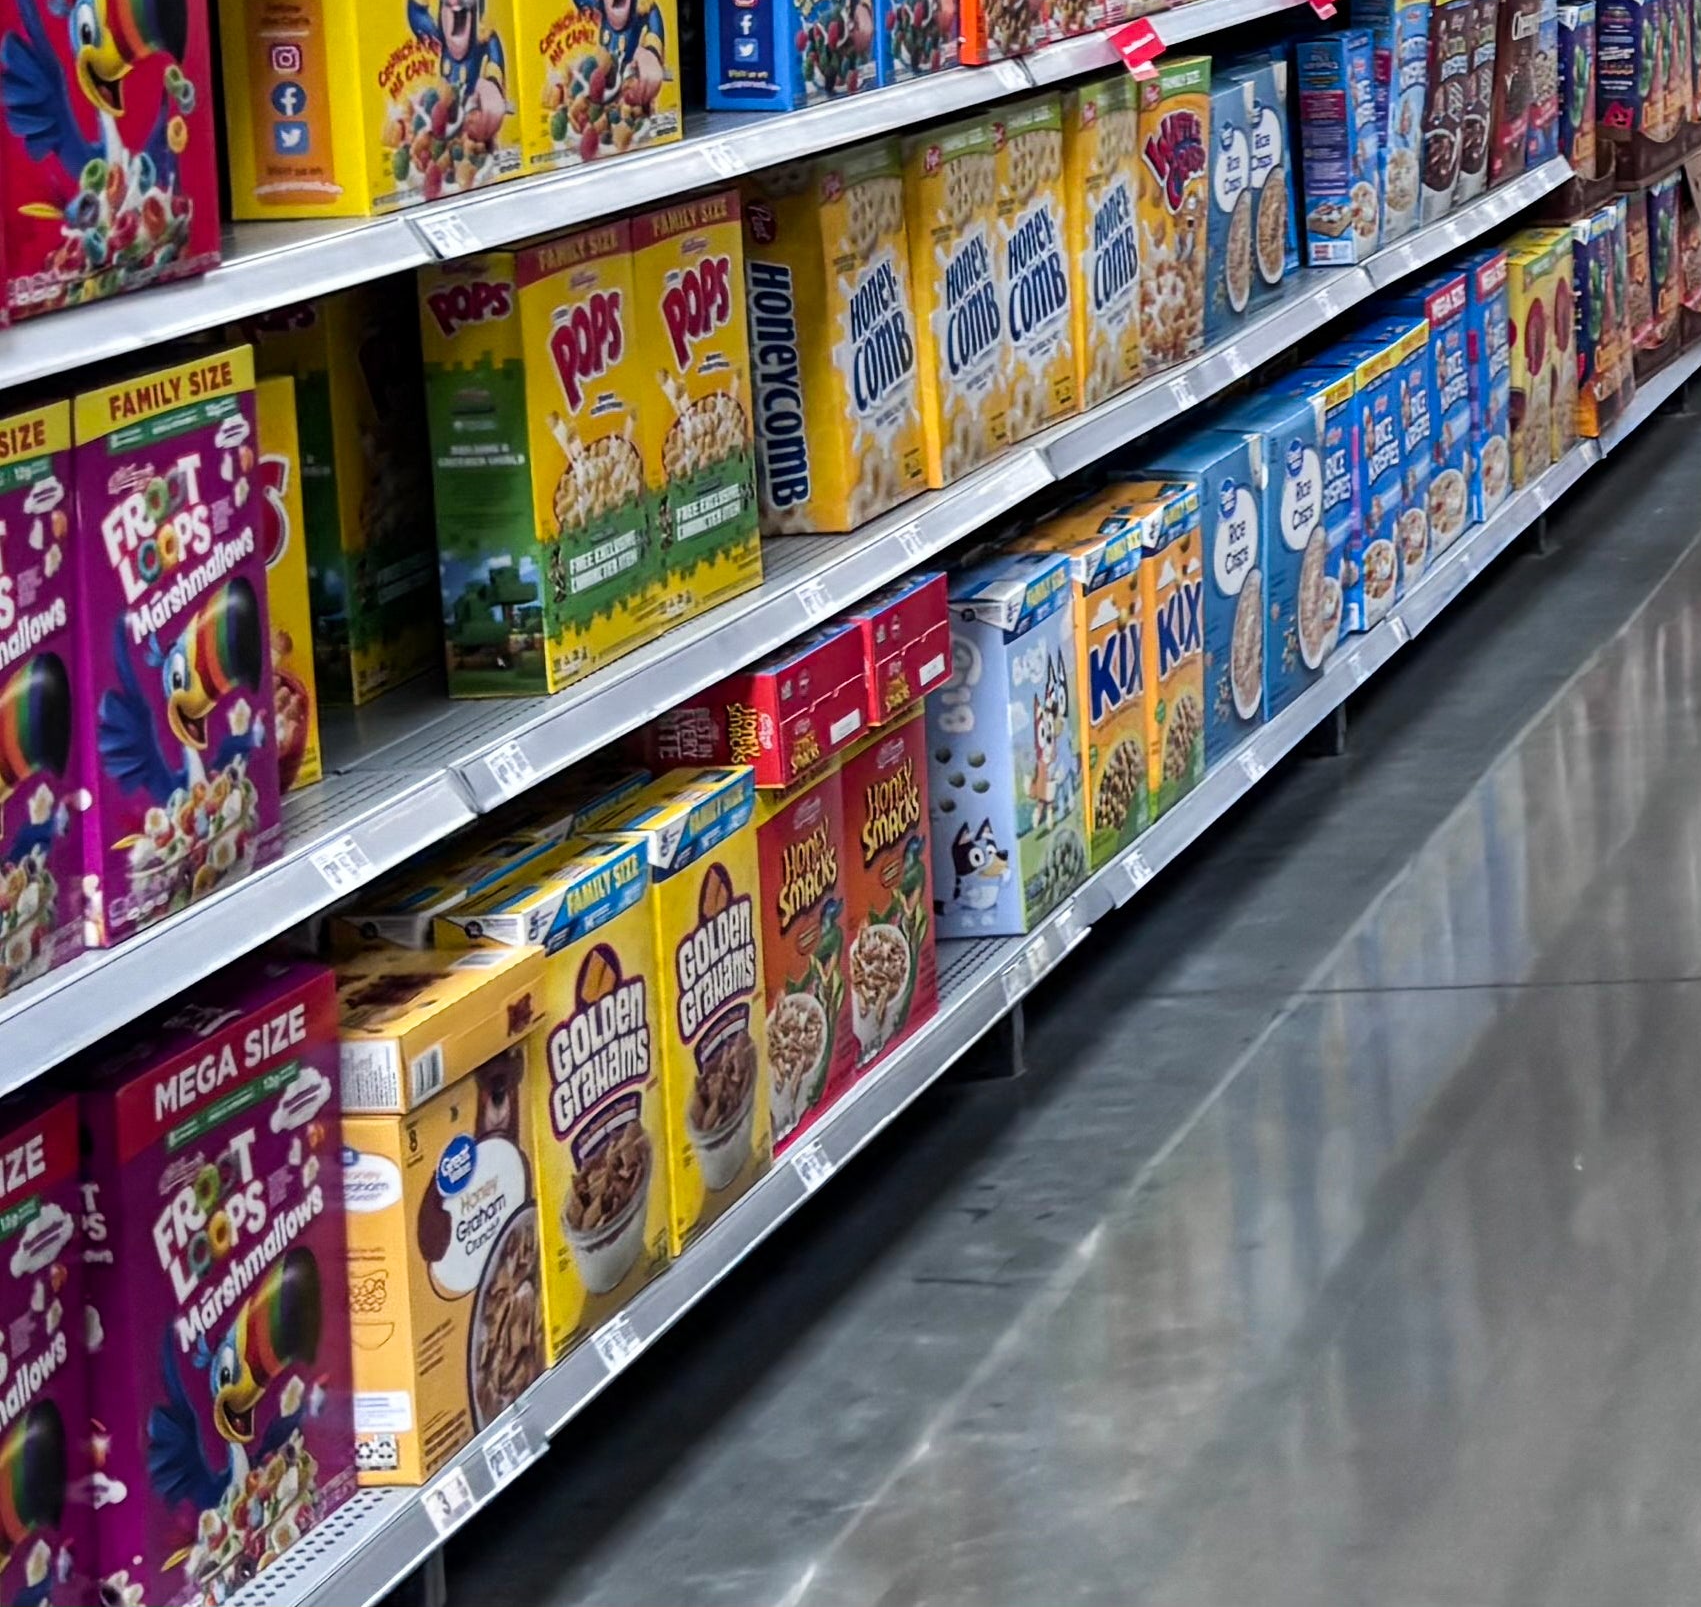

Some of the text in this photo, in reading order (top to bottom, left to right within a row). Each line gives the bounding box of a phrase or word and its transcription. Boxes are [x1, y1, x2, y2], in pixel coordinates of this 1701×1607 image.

[427, 280, 510, 339] POPS
[550, 290, 623, 415] POPS
[662, 256, 730, 372] POPS
[109, 361, 234, 423] FAMILY SIZE
[102, 455, 202, 567] FROOT
[119, 504, 211, 604] LOOPS
[131, 526, 254, 644] Marshmallows
[1156, 582, 1202, 680] KIX
[1090, 623, 1143, 725] KIX
[861, 788, 921, 868] SMACKS
[777, 846, 838, 934] SMACKS
[154, 1004, 307, 1122] MEGA SIZE
[408, 1127, 419, 1151] 8
[440, 1141, 471, 1173] Great
[153, 1128, 257, 1269] FROOT
[168, 1181, 267, 1302] LOOPS
[456, 1194, 508, 1241] Graham
[460, 1177, 498, 1215] Honey
[177, 1185, 323, 1352] Marshmallows
